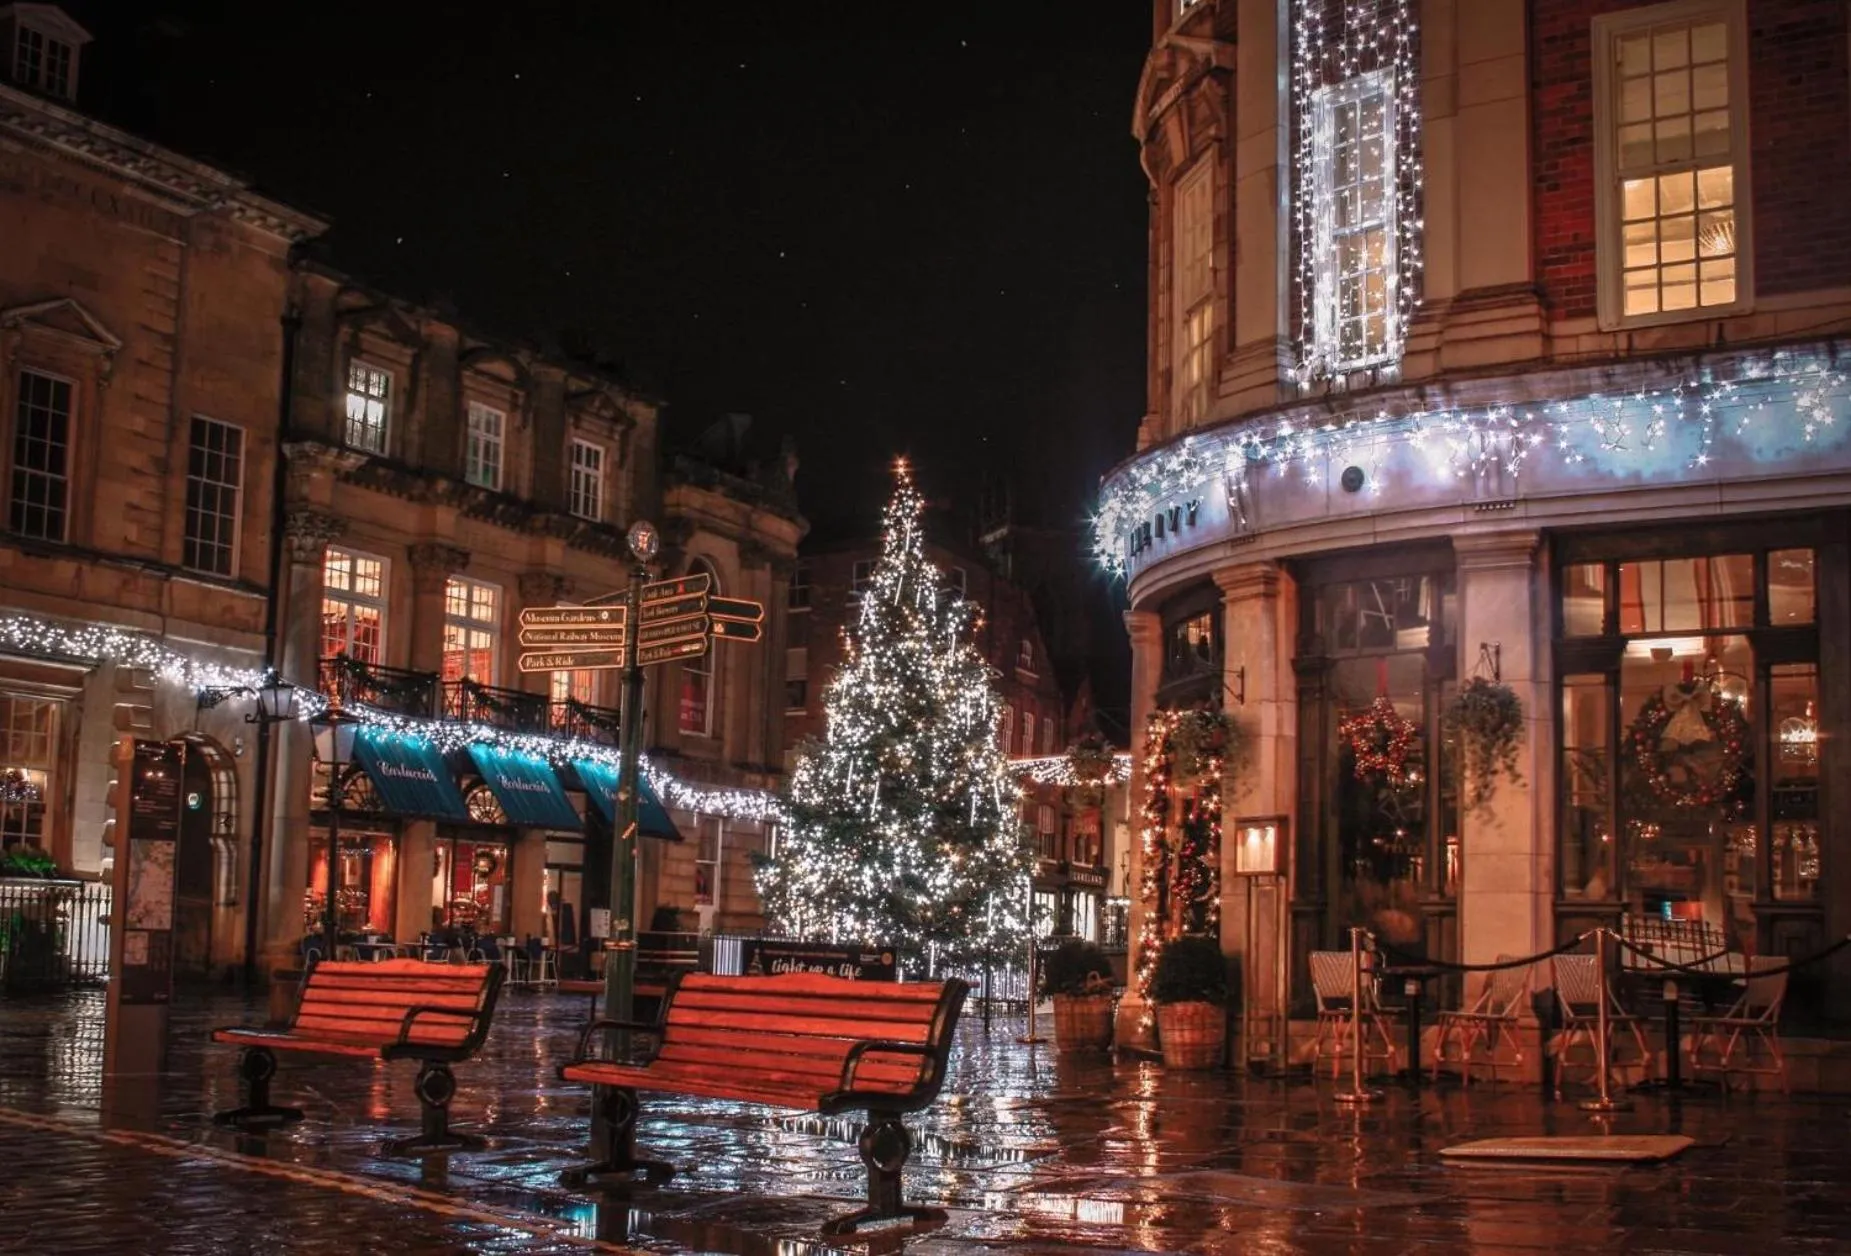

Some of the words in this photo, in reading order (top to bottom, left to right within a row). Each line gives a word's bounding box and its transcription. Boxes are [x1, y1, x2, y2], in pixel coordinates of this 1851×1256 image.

[1155, 499, 1200, 538] IVY
[525, 612, 560, 622] Museum
[561, 611, 597, 622] Gardens
[525, 632, 558, 641] National
[559, 631, 588, 642] Railway
[590, 631, 623, 641] Museum
[526, 656, 545, 667] Park
[546, 657, 554, 666] &
[555, 655, 575, 666] Ride
[827, 966, 834, 975] a
